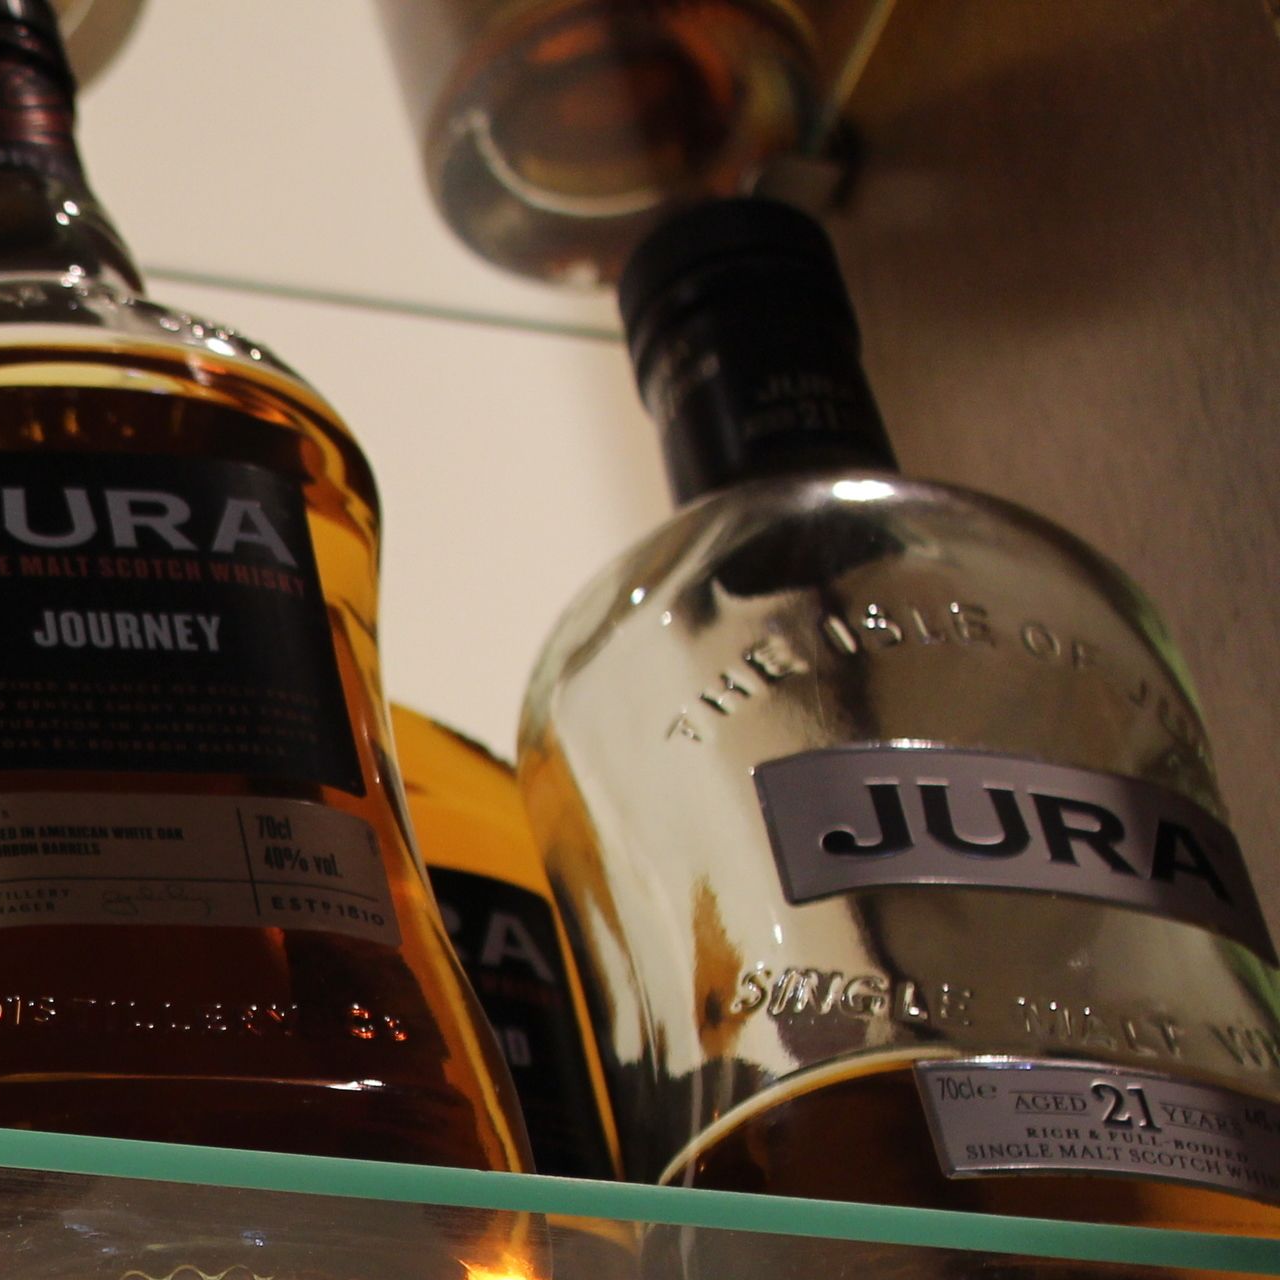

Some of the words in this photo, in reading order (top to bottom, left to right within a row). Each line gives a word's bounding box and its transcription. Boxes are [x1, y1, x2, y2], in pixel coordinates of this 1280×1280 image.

[18, 553, 89, 580] MALT
[97, 555, 202, 582] SCOTCH
[208, 560, 306, 598] WHISKY
[33, 609, 221, 652] JOURNEY
[20, 825, 36, 839] IN
[39, 824, 109, 840] AMERICAN
[112, 825, 156, 841] WHITE
[157, 826, 185, 841] OAK
[255, 813, 292, 841] 70cl
[41, 842, 101, 857] BARRELS
[822, 781, 1235, 907] JURA
[264, 845, 310, 873] 40%
[312, 852, 344, 879] vol.
[336, 902, 385, 927] 1810
[730, 962, 972, 1029] SINGLE
[1015, 1094, 1088, 1112] AGED
[1090, 1079, 1162, 1133] 21
[1161, 1105, 1244, 1136] YEARS
[1026, 1127, 1080, 1139] RICH
[966, 1142, 1054, 1161] SINGLE
[1059, 1144, 1122, 1162] MALT
[1129, 1149, 1221, 1175] SCOTCH
